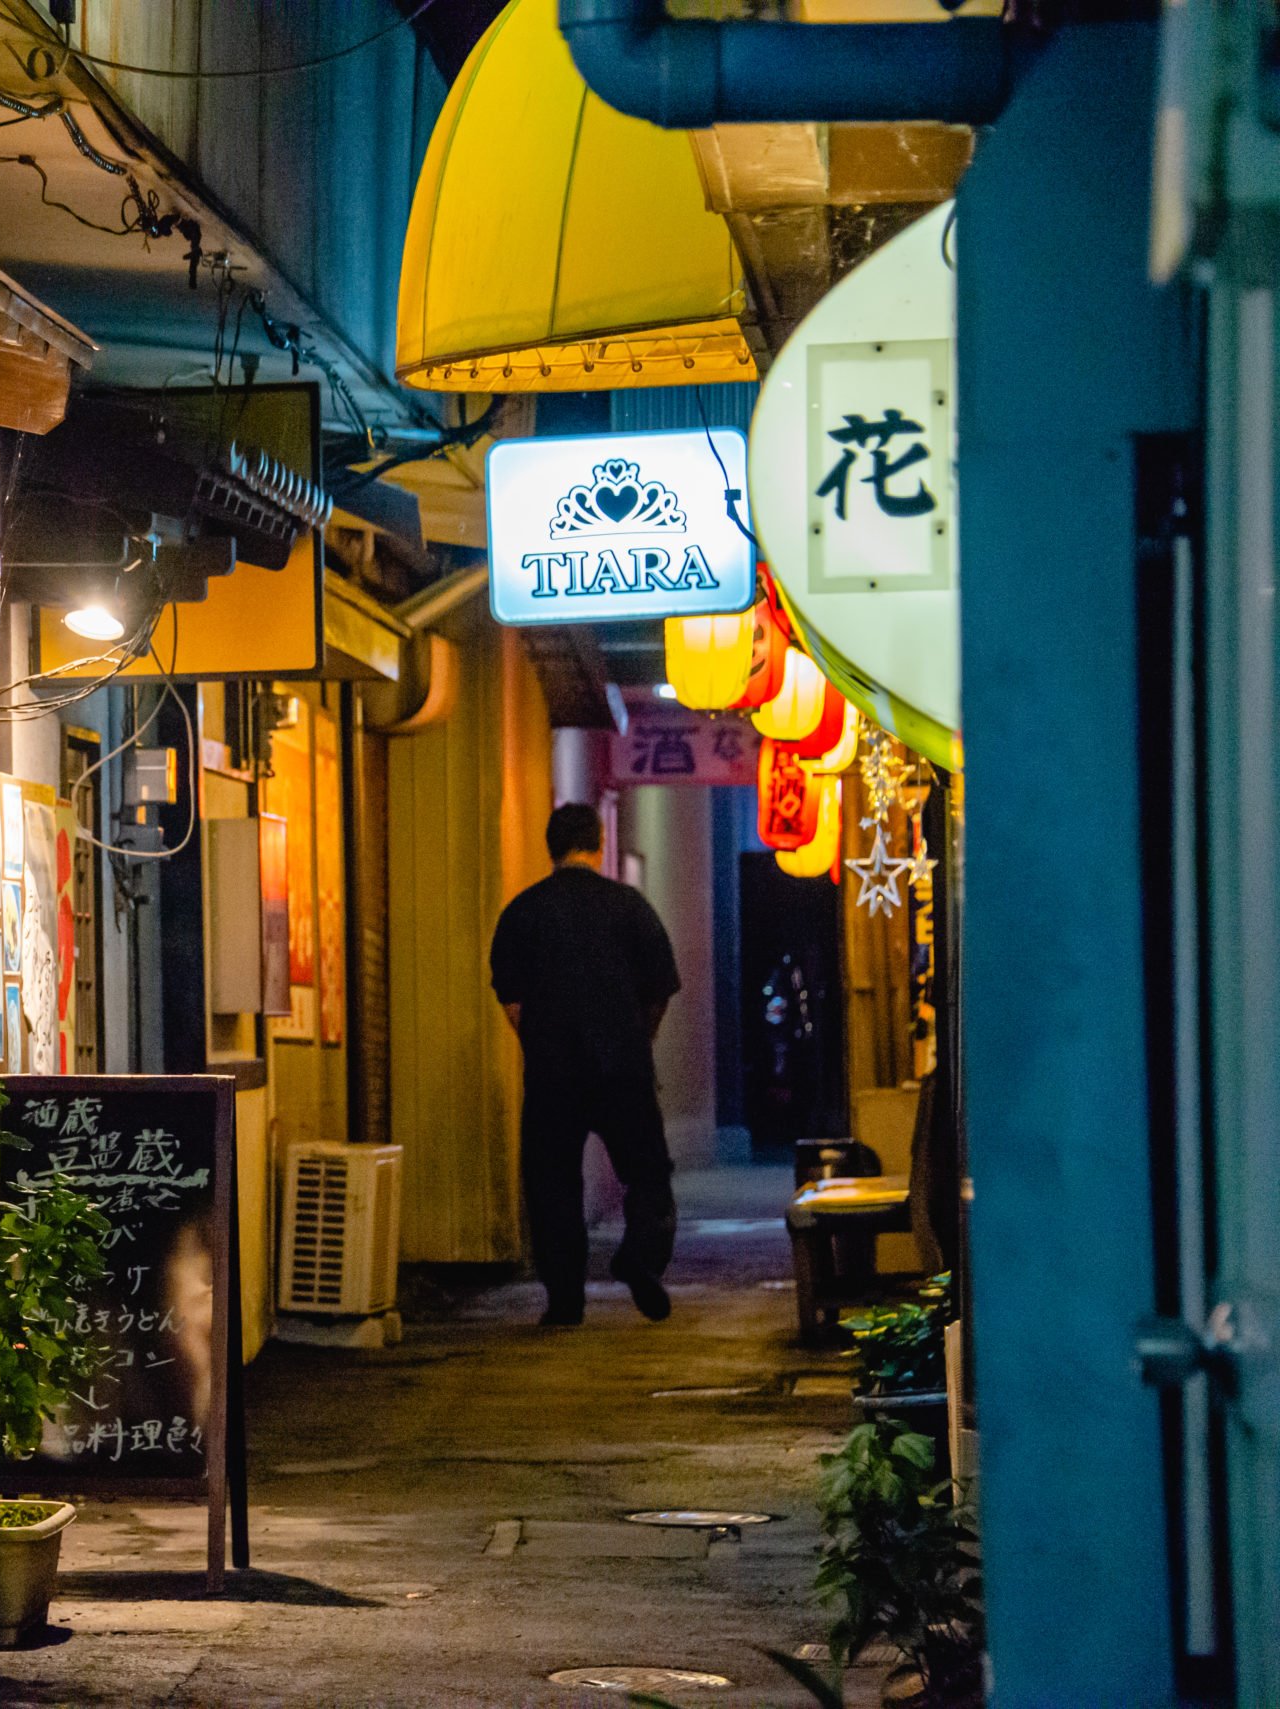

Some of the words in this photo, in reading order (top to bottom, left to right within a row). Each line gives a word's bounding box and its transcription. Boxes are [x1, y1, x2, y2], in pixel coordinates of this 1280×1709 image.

[815, 409, 938, 521] 花
[521, 544, 720, 598] TIARA
[22, 1096, 104, 1137] 酒蔵
